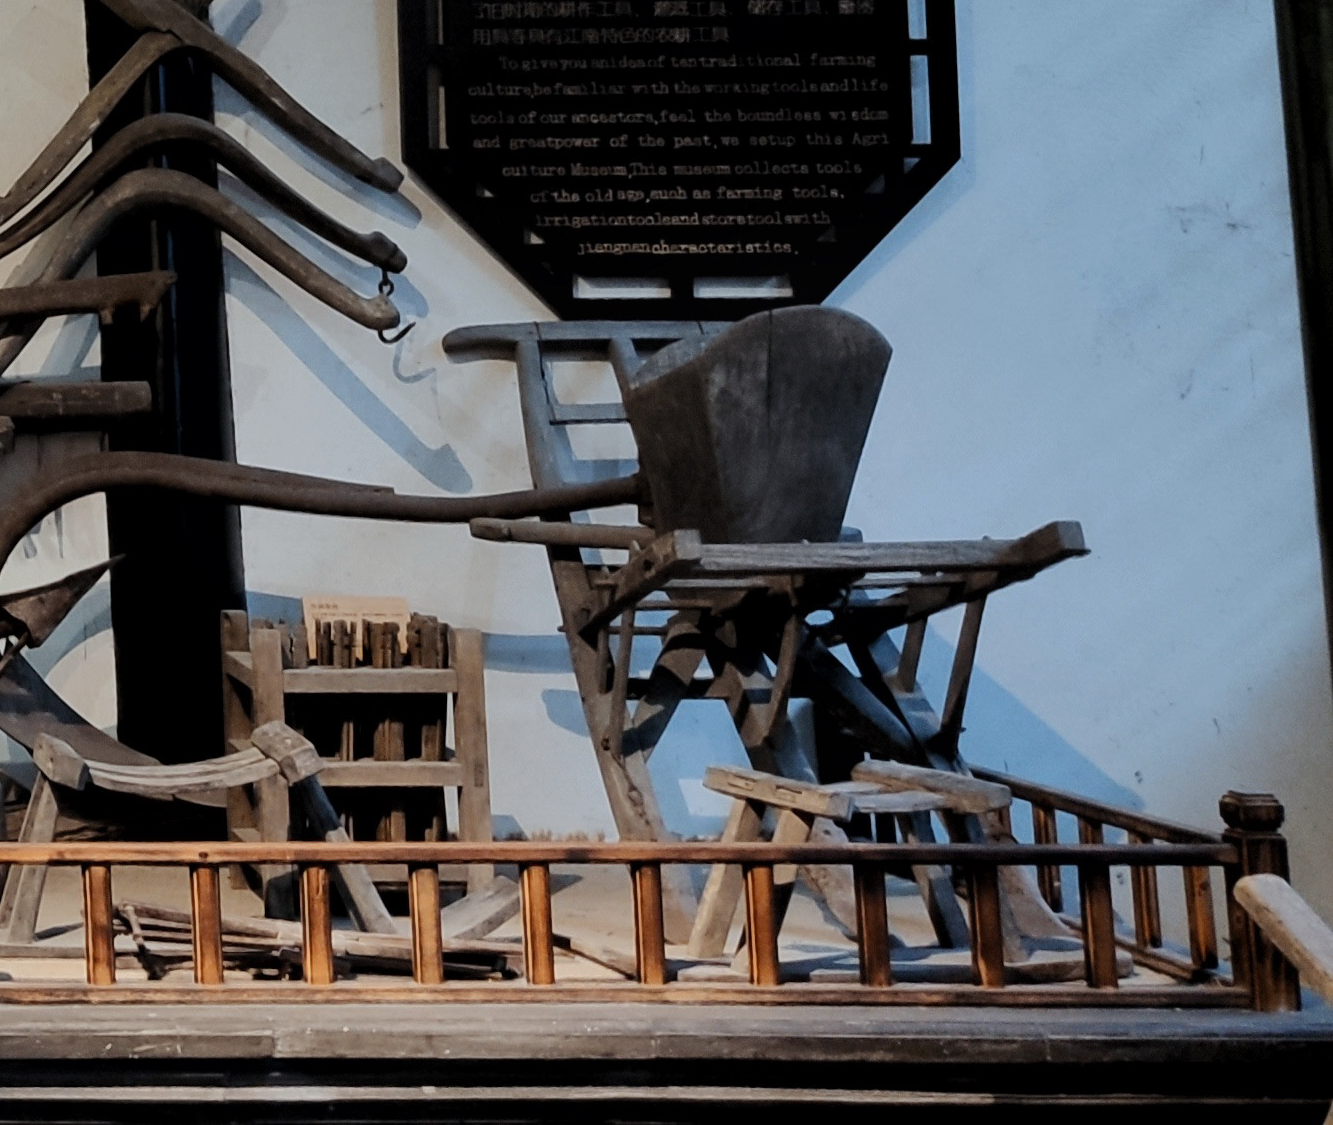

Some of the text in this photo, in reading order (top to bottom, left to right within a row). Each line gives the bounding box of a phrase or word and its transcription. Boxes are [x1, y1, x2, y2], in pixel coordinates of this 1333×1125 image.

[469, 110, 515, 125] tools
[517, 110, 538, 125] of
[539, 113, 568, 124] our
[704, 109, 732, 123] the
[736, 107, 822, 123] boundless
[472, 135, 502, 149] and
[609, 134, 629, 148] of
[637, 134, 666, 148] the
[806, 132, 843, 146] this
[851, 132, 891, 148] Agri
[501, 164, 567, 177] culture
[673, 165, 732, 176] museum
[735, 160, 809, 176] collects
[816, 160, 863, 175] tools
[550, 189, 580, 203] the
[585, 188, 614, 203] old
[692, 189, 712, 200] as
[716, 186, 783, 202] farming
